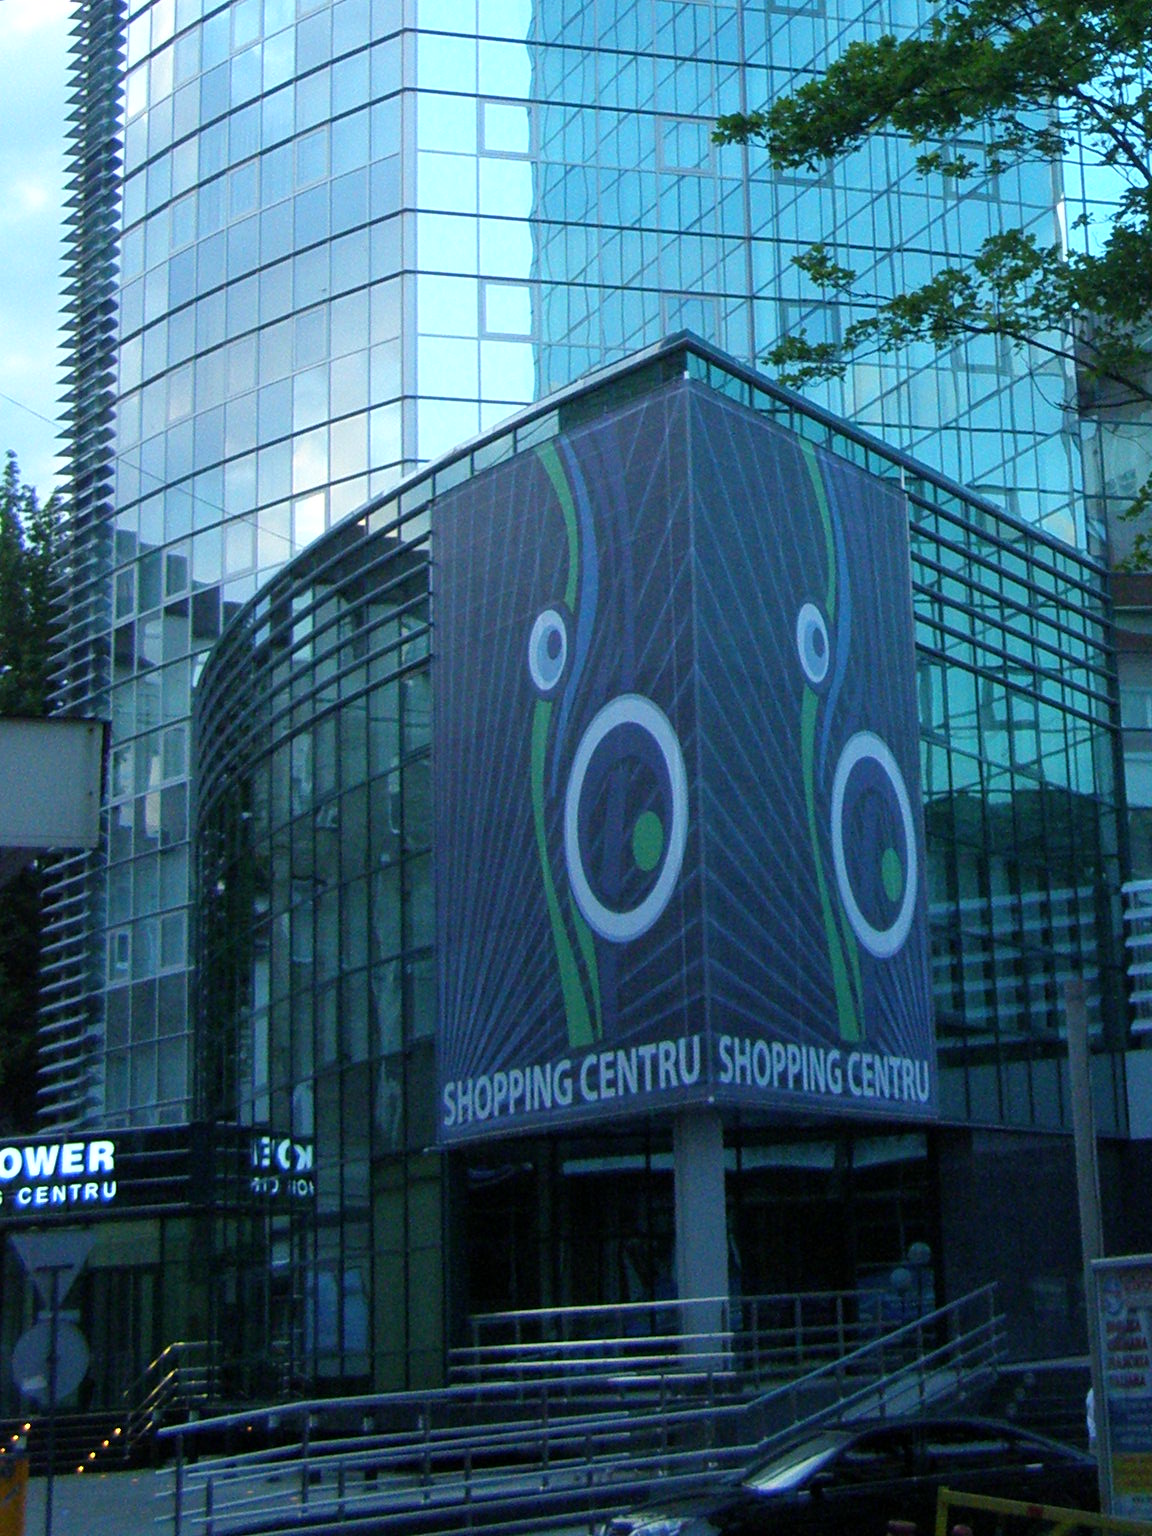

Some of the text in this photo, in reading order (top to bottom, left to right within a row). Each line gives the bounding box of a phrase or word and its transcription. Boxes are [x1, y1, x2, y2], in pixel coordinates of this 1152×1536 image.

[443, 1034, 701, 1126] SHOPPING CENTRU
[719, 1034, 929, 1102] SHOPPING CENTRU
[17, 1180, 118, 1205] CENTRU
